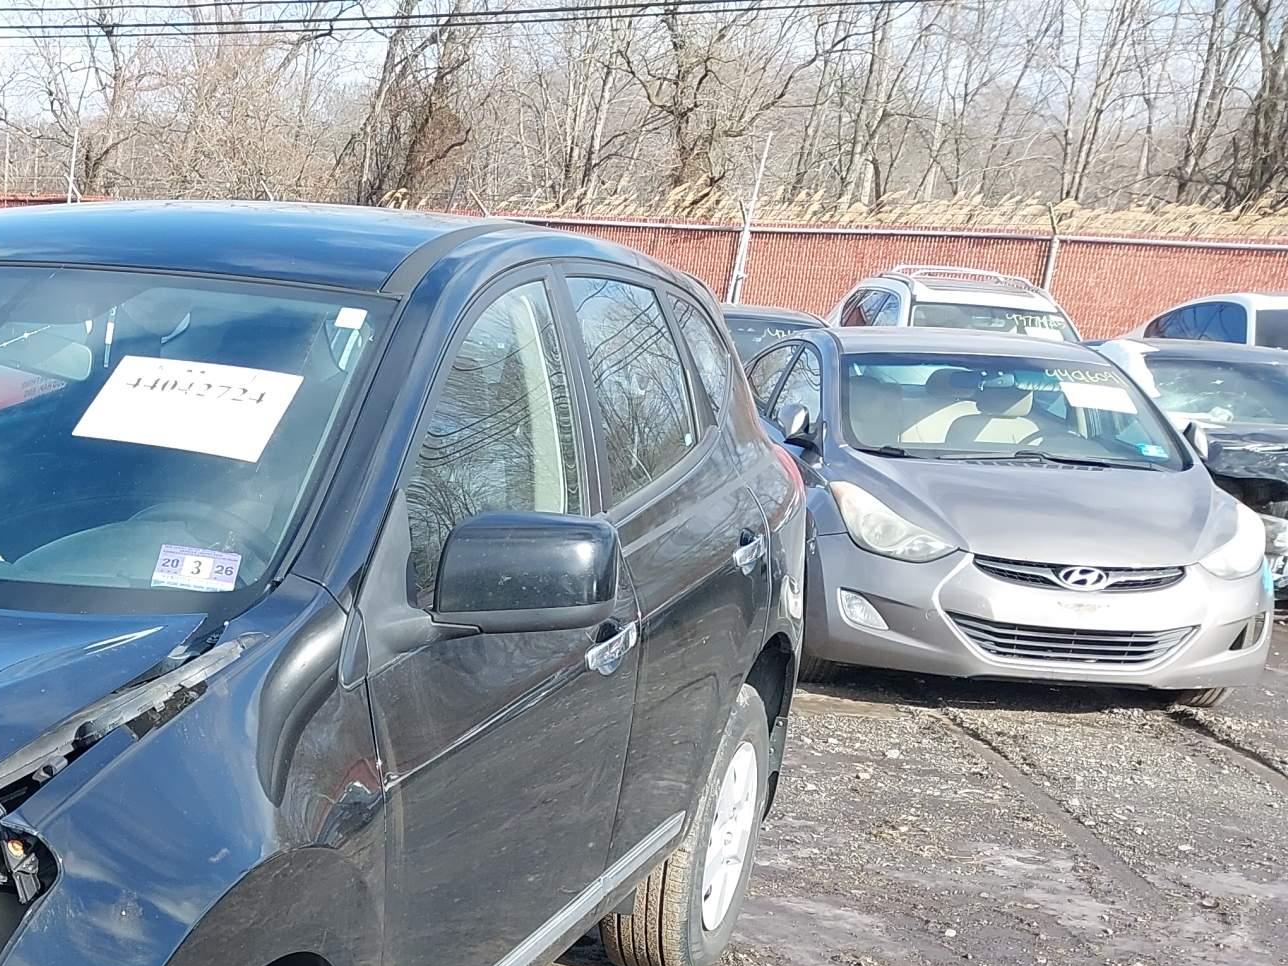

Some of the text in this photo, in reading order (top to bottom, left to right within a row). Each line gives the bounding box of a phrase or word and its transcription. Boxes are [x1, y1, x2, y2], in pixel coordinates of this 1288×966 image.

[161, 558, 234, 576] 20 3 26
